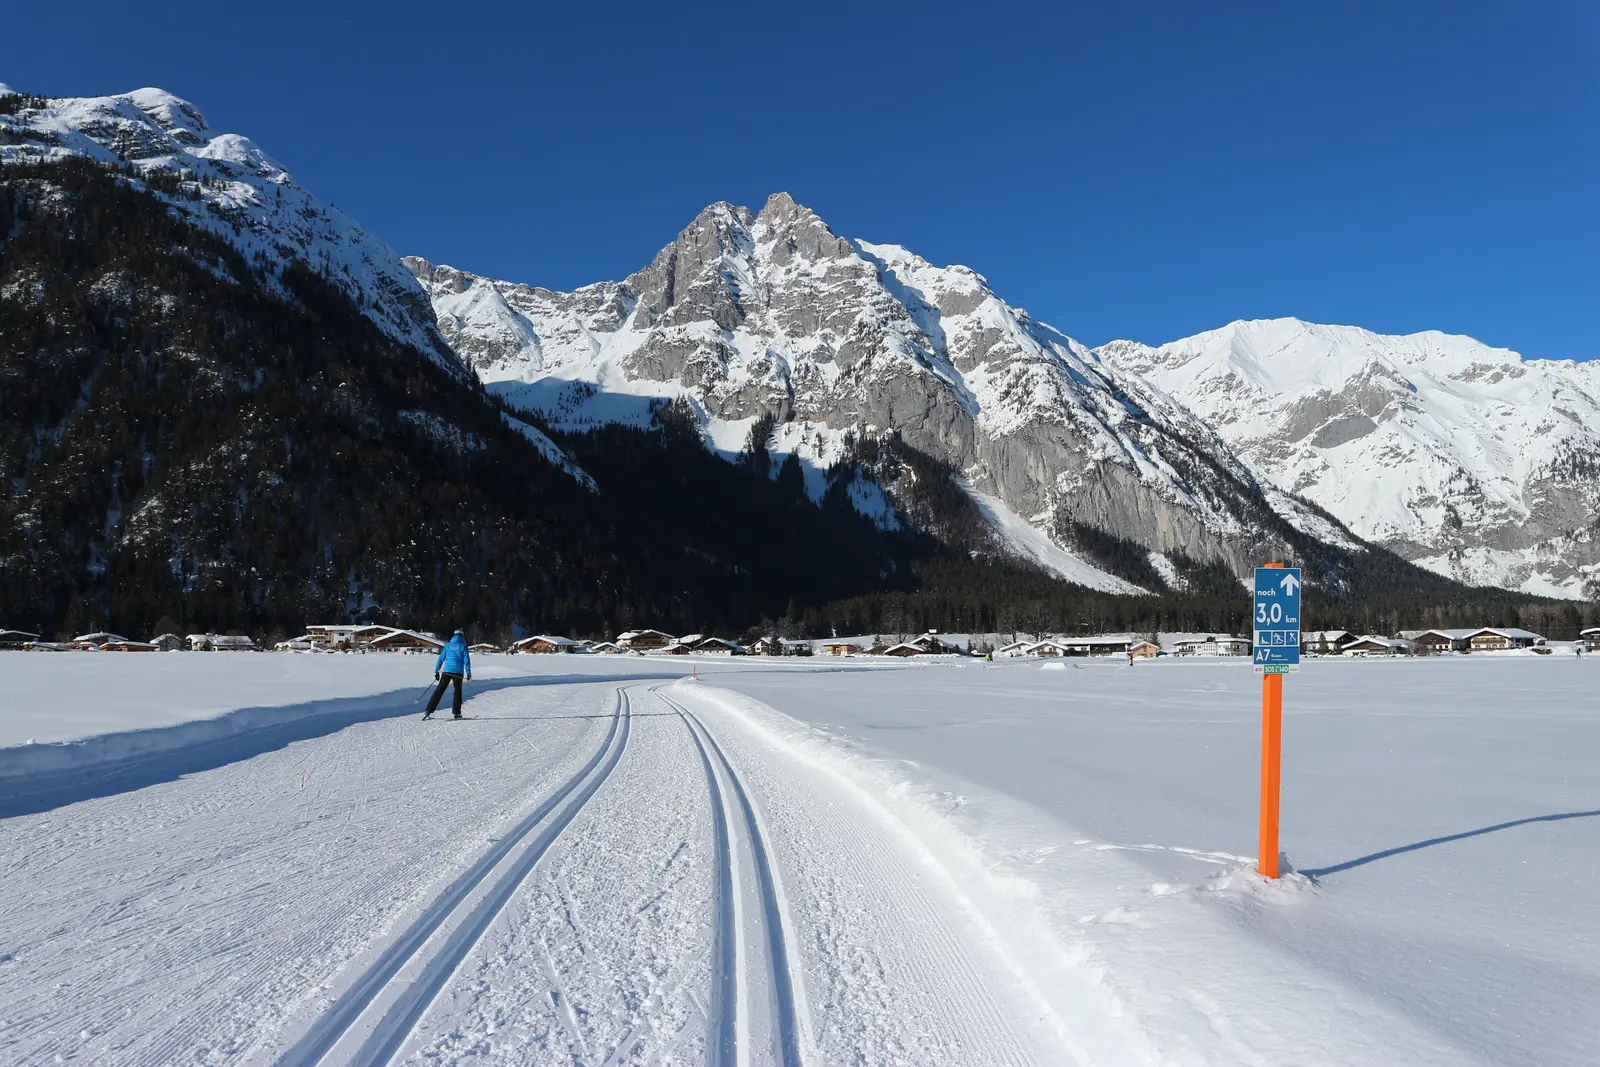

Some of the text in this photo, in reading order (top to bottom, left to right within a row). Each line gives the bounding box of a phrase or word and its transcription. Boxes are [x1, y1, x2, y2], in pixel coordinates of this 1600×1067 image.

[1257, 588, 1276, 596] noch
[1256, 602, 1297, 626] 3,0 km
[1256, 649, 1271, 661] A7
